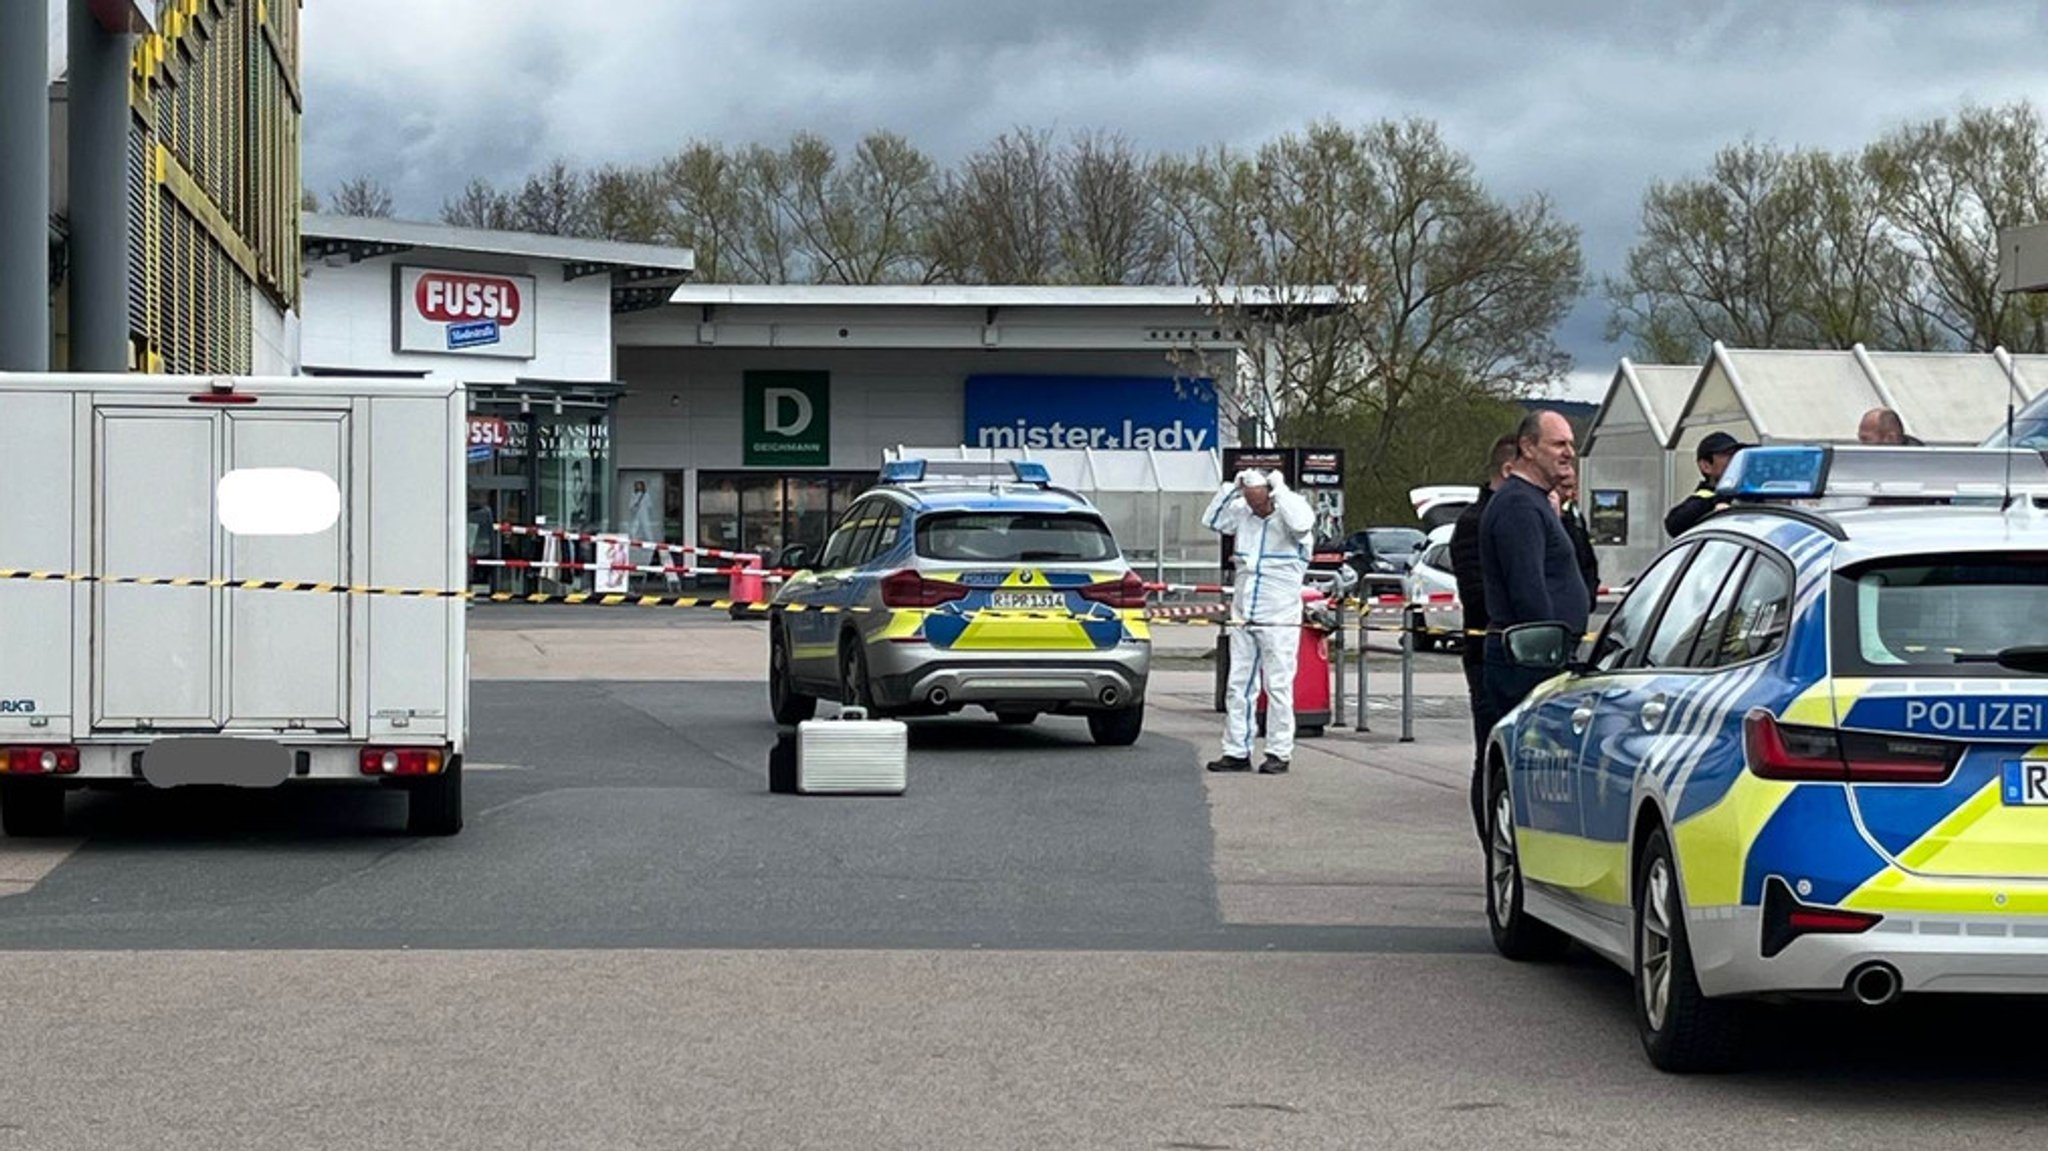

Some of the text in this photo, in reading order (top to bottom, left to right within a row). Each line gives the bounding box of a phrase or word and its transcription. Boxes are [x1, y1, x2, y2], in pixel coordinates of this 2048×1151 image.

[426, 280, 513, 319] FUSSL
[764, 387, 813, 436] D
[753, 442, 821, 452] DEICHMANN
[1906, 701, 2042, 731] POLIZEI
